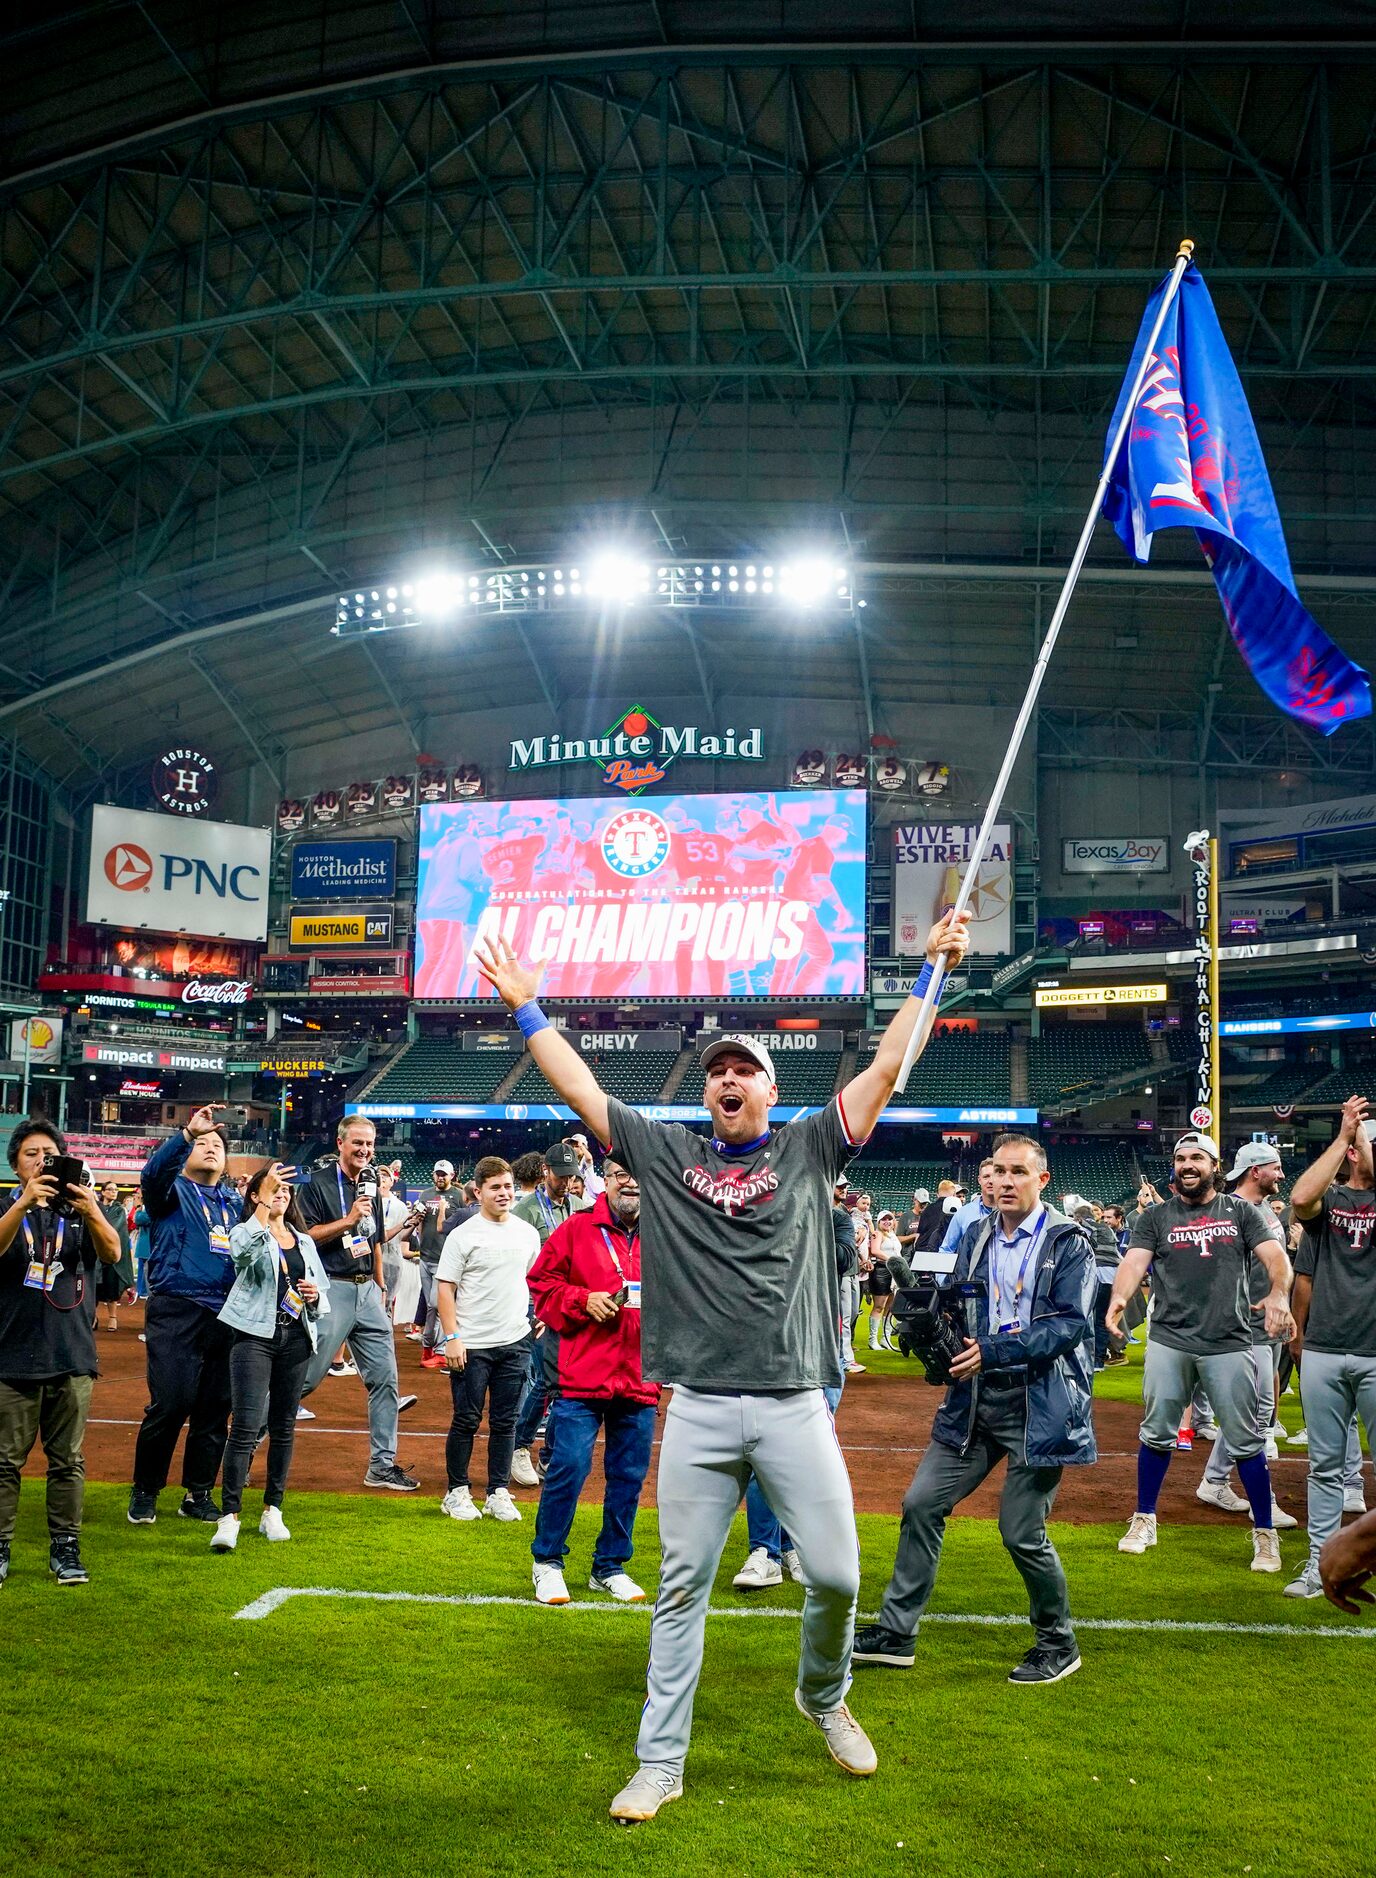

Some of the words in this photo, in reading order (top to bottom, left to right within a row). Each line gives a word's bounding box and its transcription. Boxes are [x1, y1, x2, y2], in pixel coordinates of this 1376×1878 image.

[508, 731, 651, 768] Minute
[659, 727, 763, 758] Maid
[161, 750, 213, 772] HOUSTON
[836, 753, 866, 773] 24
[884, 757, 898, 777] 5
[926, 761, 940, 782] 7
[176, 769, 200, 793] H
[420, 768, 445, 789] 34
[603, 760, 664, 786] Park
[162, 793, 208, 812] ASTROS
[314, 791, 339, 810] 40
[349, 783, 374, 803] 25
[611, 812, 660, 831] TEXAS
[625, 831, 648, 858] T
[687, 841, 719, 862] 53
[1069, 841, 1119, 859] Texas
[1127, 841, 1162, 863] Bay
[299, 858, 387, 879] Methodist
[606, 848, 666, 875] RANGERS
[160, 854, 260, 902] PNC
[491, 889, 613, 900] CONGRATULATIONS
[621, 889, 636, 897] TO
[643, 888, 667, 896] THE
[675, 887, 716, 896] TEXAS
[723, 886, 785, 895] RANGERS
[1194, 870, 1210, 928] ROOT
[303, 923, 359, 936] MUSTANG
[367, 922, 388, 936] CAT
[529, 901, 810, 963] CHAMPIONS
[1196, 958, 1210, 1005] THA
[85, 994, 135, 1009] HORNITOS
[137, 1001, 161, 1010] TEQUILA
[163, 1003, 175, 1011] BAR
[1042, 993, 1100, 1002] DOGGETT
[1119, 988, 1158, 999] RENTS
[1224, 1021, 1282, 1033] RANGERS
[580, 1034, 639, 1050] CHEVY
[98, 1047, 153, 1064] impact
[171, 1054, 223, 1070] impact
[261, 1061, 325, 1071] PLUCKERS
[1197, 1011, 1211, 1103] CHIKIN
[357, 1106, 416, 1116] RANGERS
[959, 1109, 1017, 1121] ASTROS
[682, 1168, 779, 1200] CHAMPIONS
[1167, 1226, 1239, 1243] CHAMPIONS
